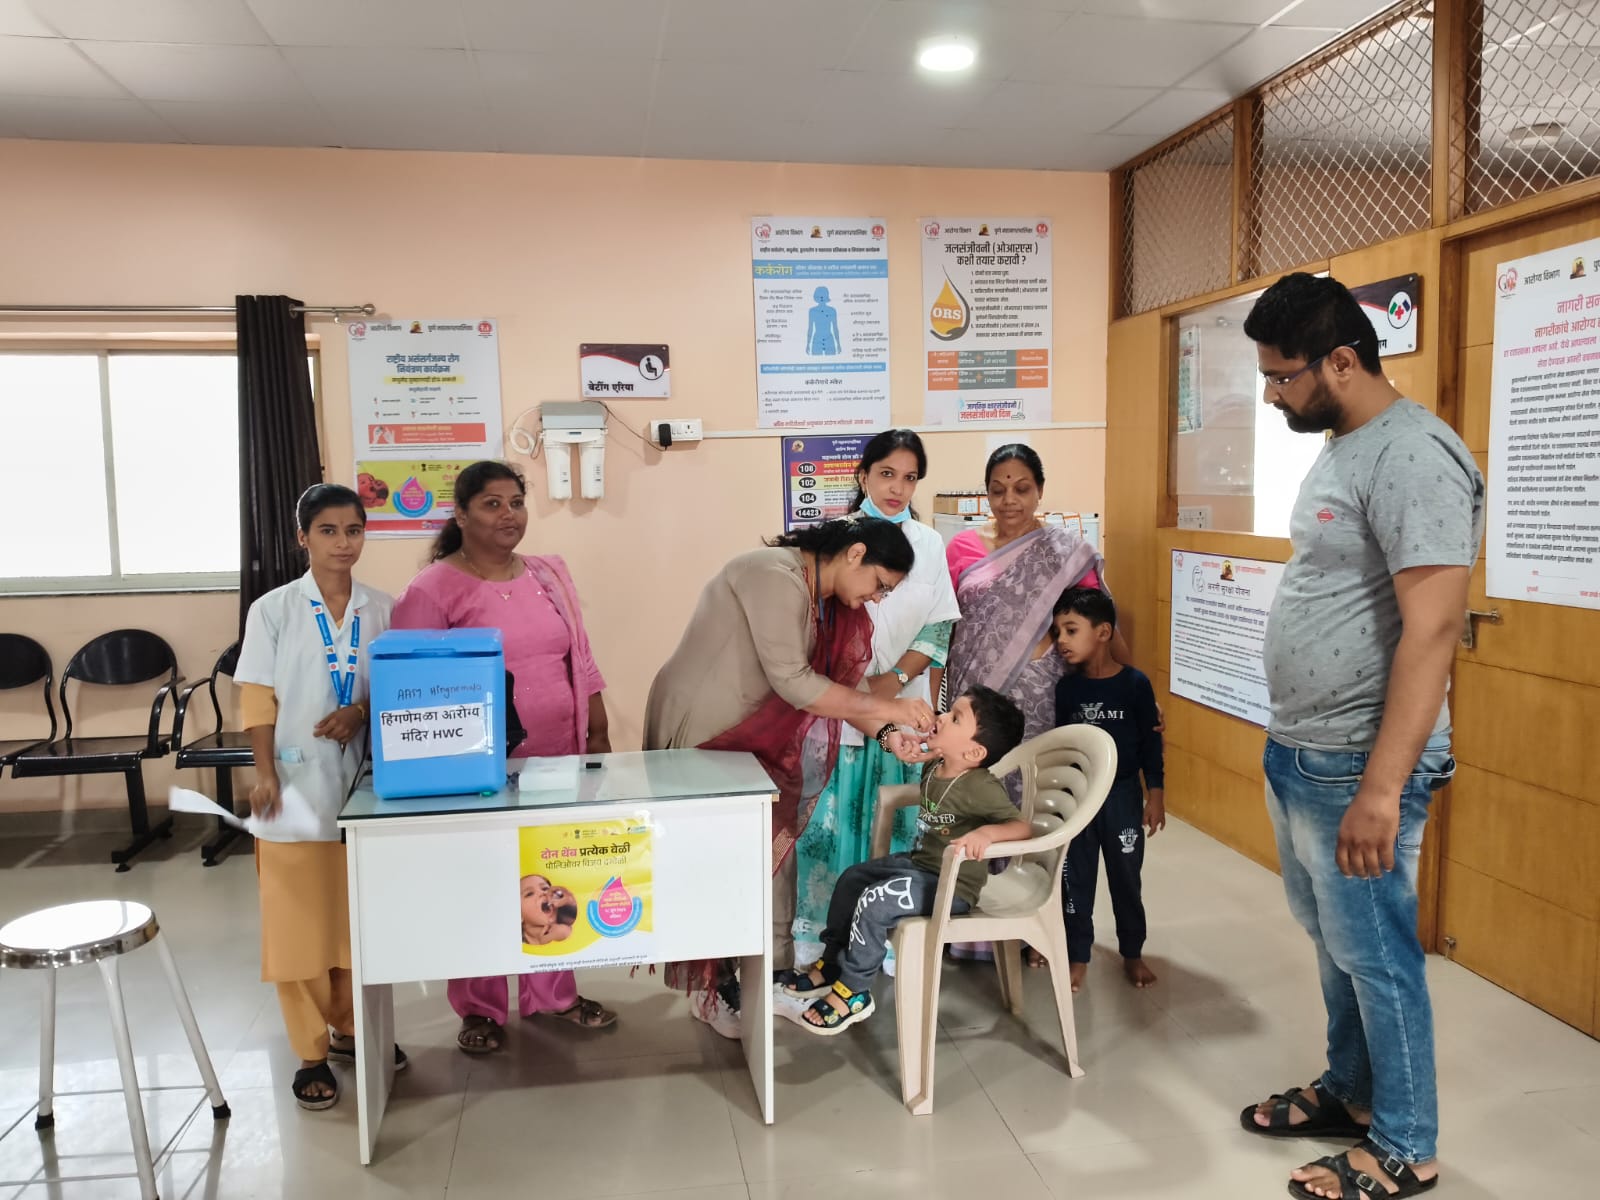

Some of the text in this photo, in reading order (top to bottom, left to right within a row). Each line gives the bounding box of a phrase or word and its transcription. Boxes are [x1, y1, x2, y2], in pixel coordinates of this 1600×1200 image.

[945, 243, 991, 254] जलसंजीवनी
[957, 254, 974, 265] कशी
[976, 256, 995, 265] तयार
[998, 254, 1019, 265] करावी
[755, 264, 792, 275] कर्करोग
[1524, 269, 1560, 285] आरोग्य विभाग
[1557, 294, 1583, 313] नागरी
[933, 307, 962, 321] ORS
[1535, 320, 1596, 339] नागरीकांचे आरोग्य
[386, 353, 460, 363] राष्ट्रीय असंसर्गजन्य रोग
[397, 363, 450, 374] नियंत्रण कार्यक्रम
[612, 381, 634, 393] एरिया
[1208, 582, 1220, 591] जननी
[1235, 586, 1250, 597] योजना
[381, 705, 480, 726] हिंगणेमळा आरोग्य
[401, 728, 463, 742] मंदिर HWC
[540, 842, 630, 860] दोन थेंब प्रत्येक वेळी
[545, 859, 581, 870] पोलिओवर
[582, 858, 601, 868] विजय
